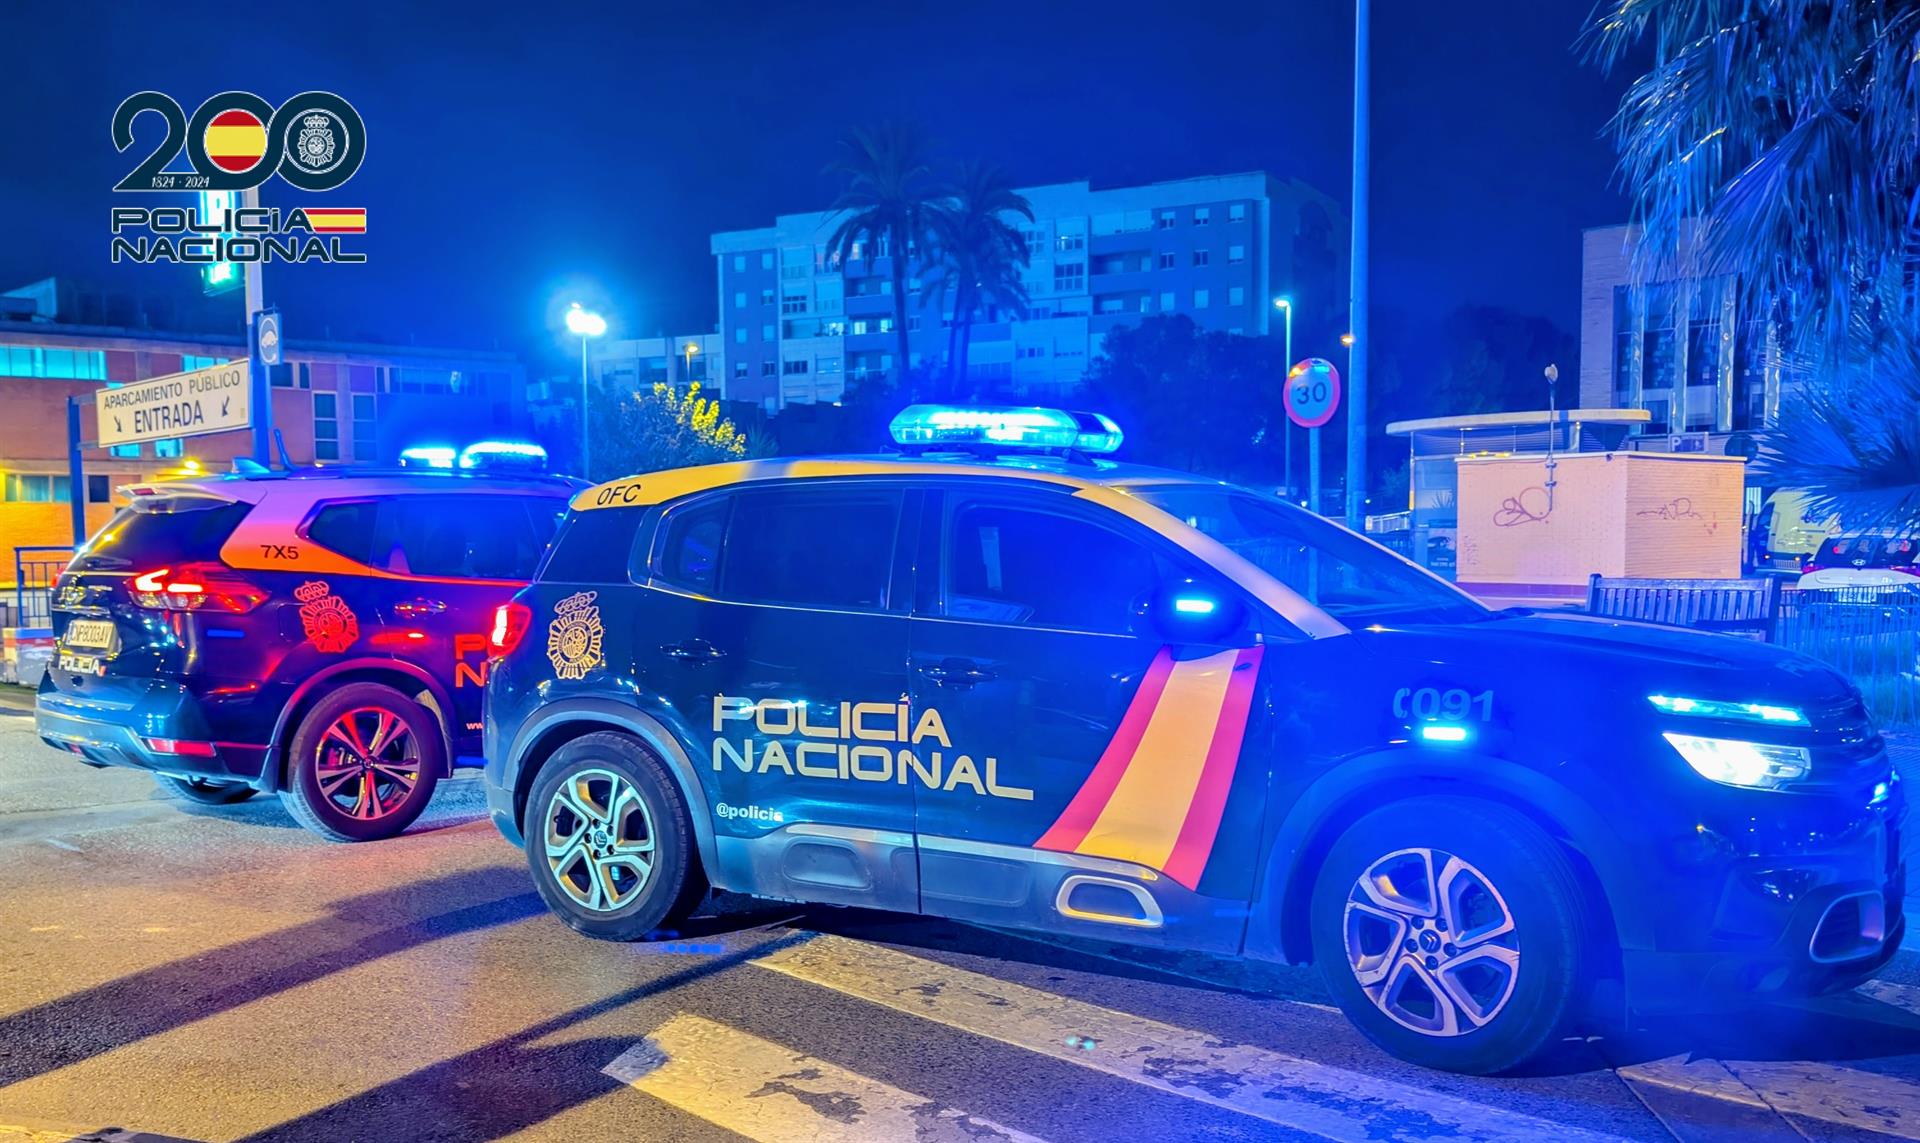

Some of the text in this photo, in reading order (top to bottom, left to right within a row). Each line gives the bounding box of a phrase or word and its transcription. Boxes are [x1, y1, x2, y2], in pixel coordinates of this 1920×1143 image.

[104, 382, 183, 410] APARCAMIENTO
[1296, 382, 1327, 405] 30
[134, 399, 204, 433] ENTRADA
[260, 544, 299, 560] 7X5
[713, 692, 952, 748] POLICÍA
[1411, 687, 1494, 722] 091
[713, 737, 1034, 801] NACIONAL
[716, 802, 784, 823] @policia
